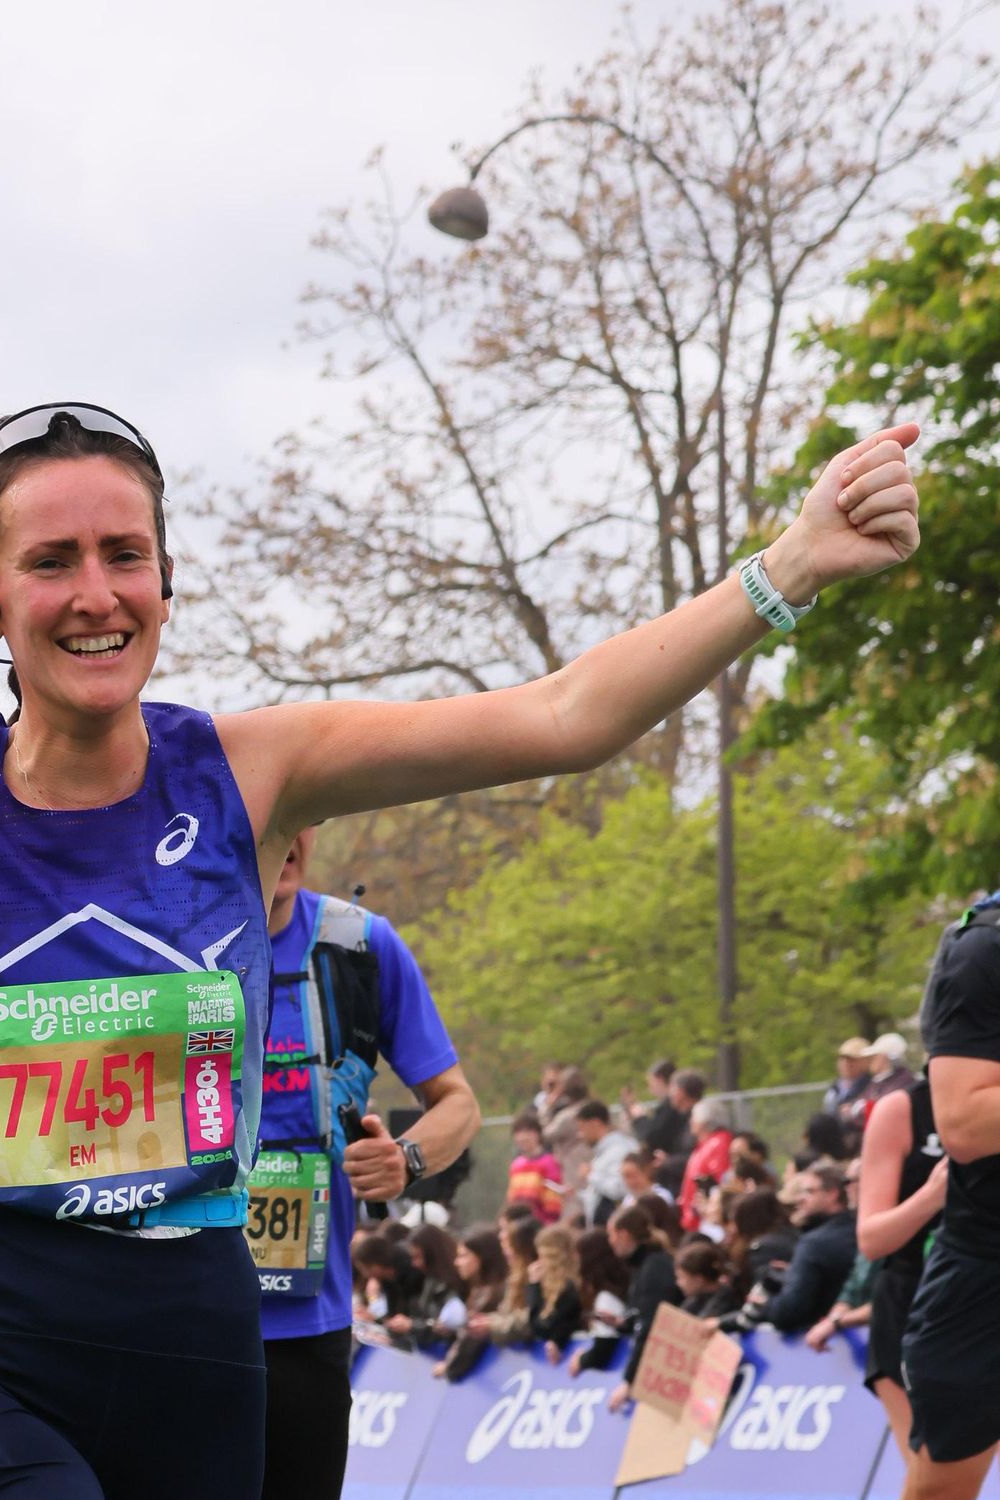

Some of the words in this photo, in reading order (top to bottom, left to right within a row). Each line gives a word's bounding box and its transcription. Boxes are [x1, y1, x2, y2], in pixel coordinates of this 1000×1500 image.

[186, 982, 231, 994] Schneider
[62, 1013, 155, 1036] Electric
[192, 1005, 236, 1025] PARIS
[196, 1060, 224, 1144] 4H30+
[70, 1143, 97, 1167] EM
[256, 1156, 299, 1173] eider
[93, 1182, 166, 1215] asics
[246, 1196, 302, 1241] 381
[258, 1274, 293, 1291] sics
